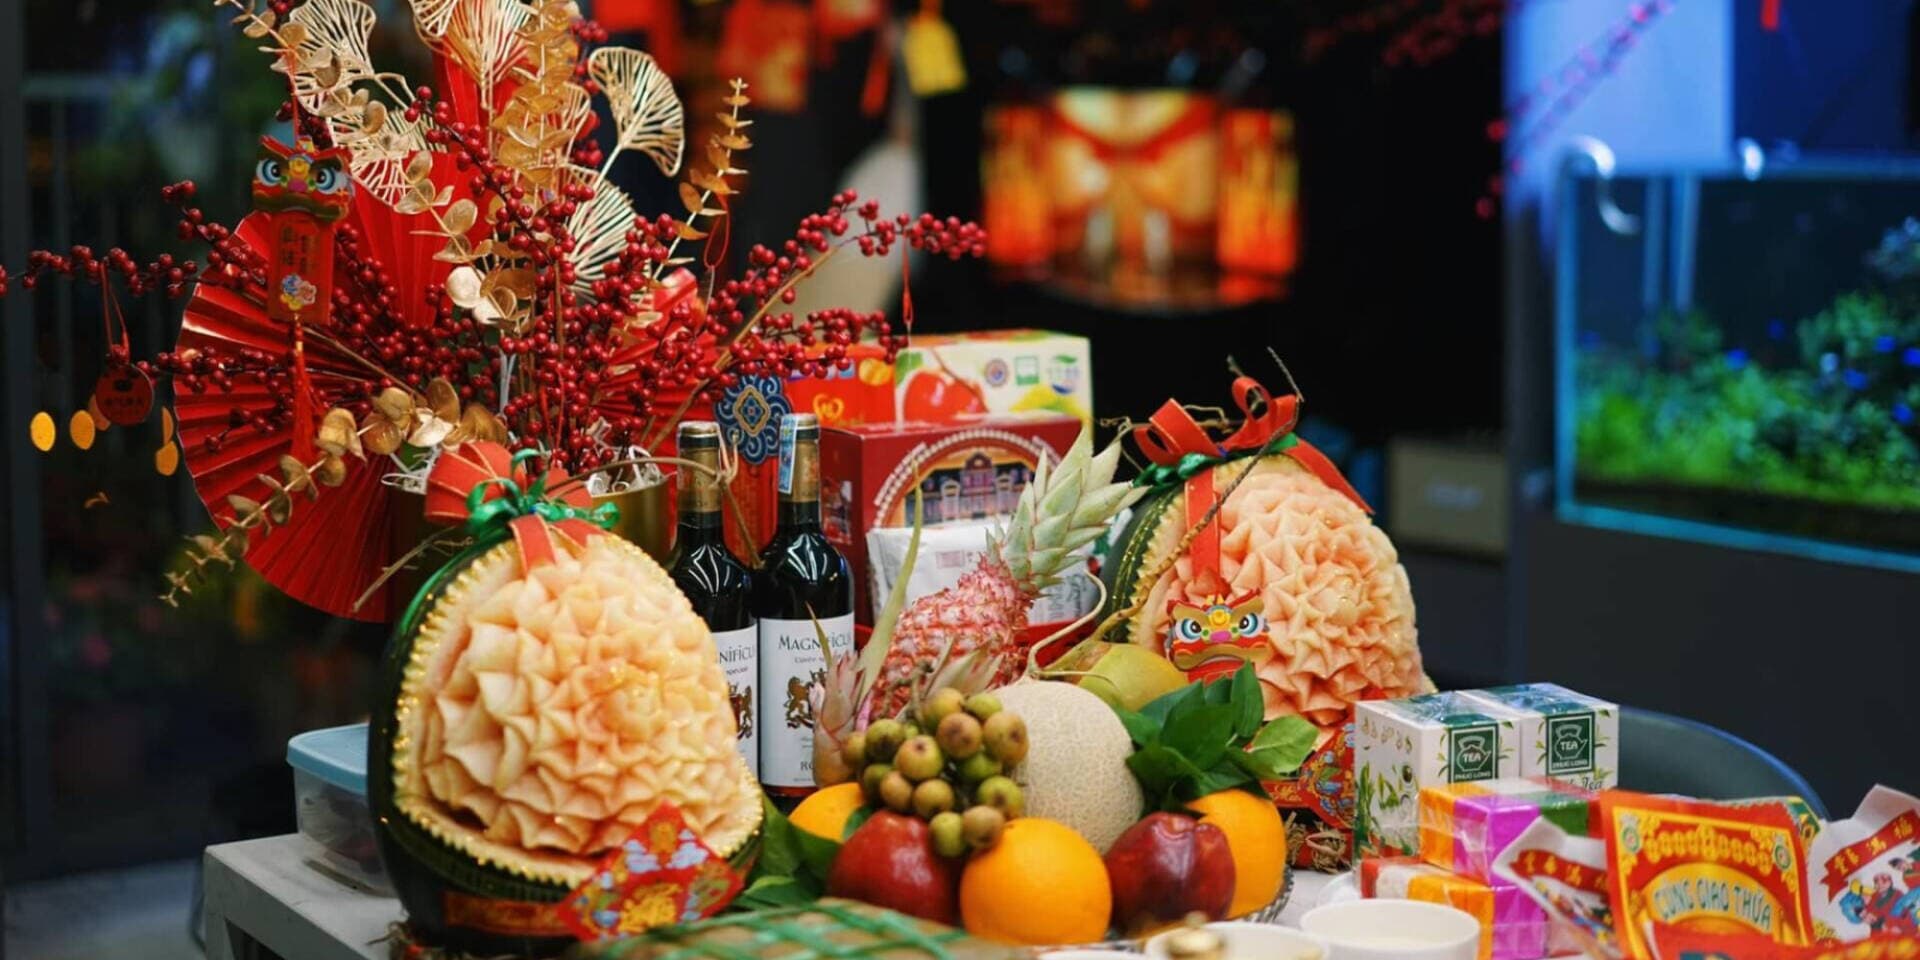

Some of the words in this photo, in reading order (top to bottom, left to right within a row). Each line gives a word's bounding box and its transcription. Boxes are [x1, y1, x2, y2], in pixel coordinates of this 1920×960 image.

[1560, 740, 1578, 751] TEA
[1462, 752, 1482, 763] TEA
[1696, 878, 1730, 912] GIAO
